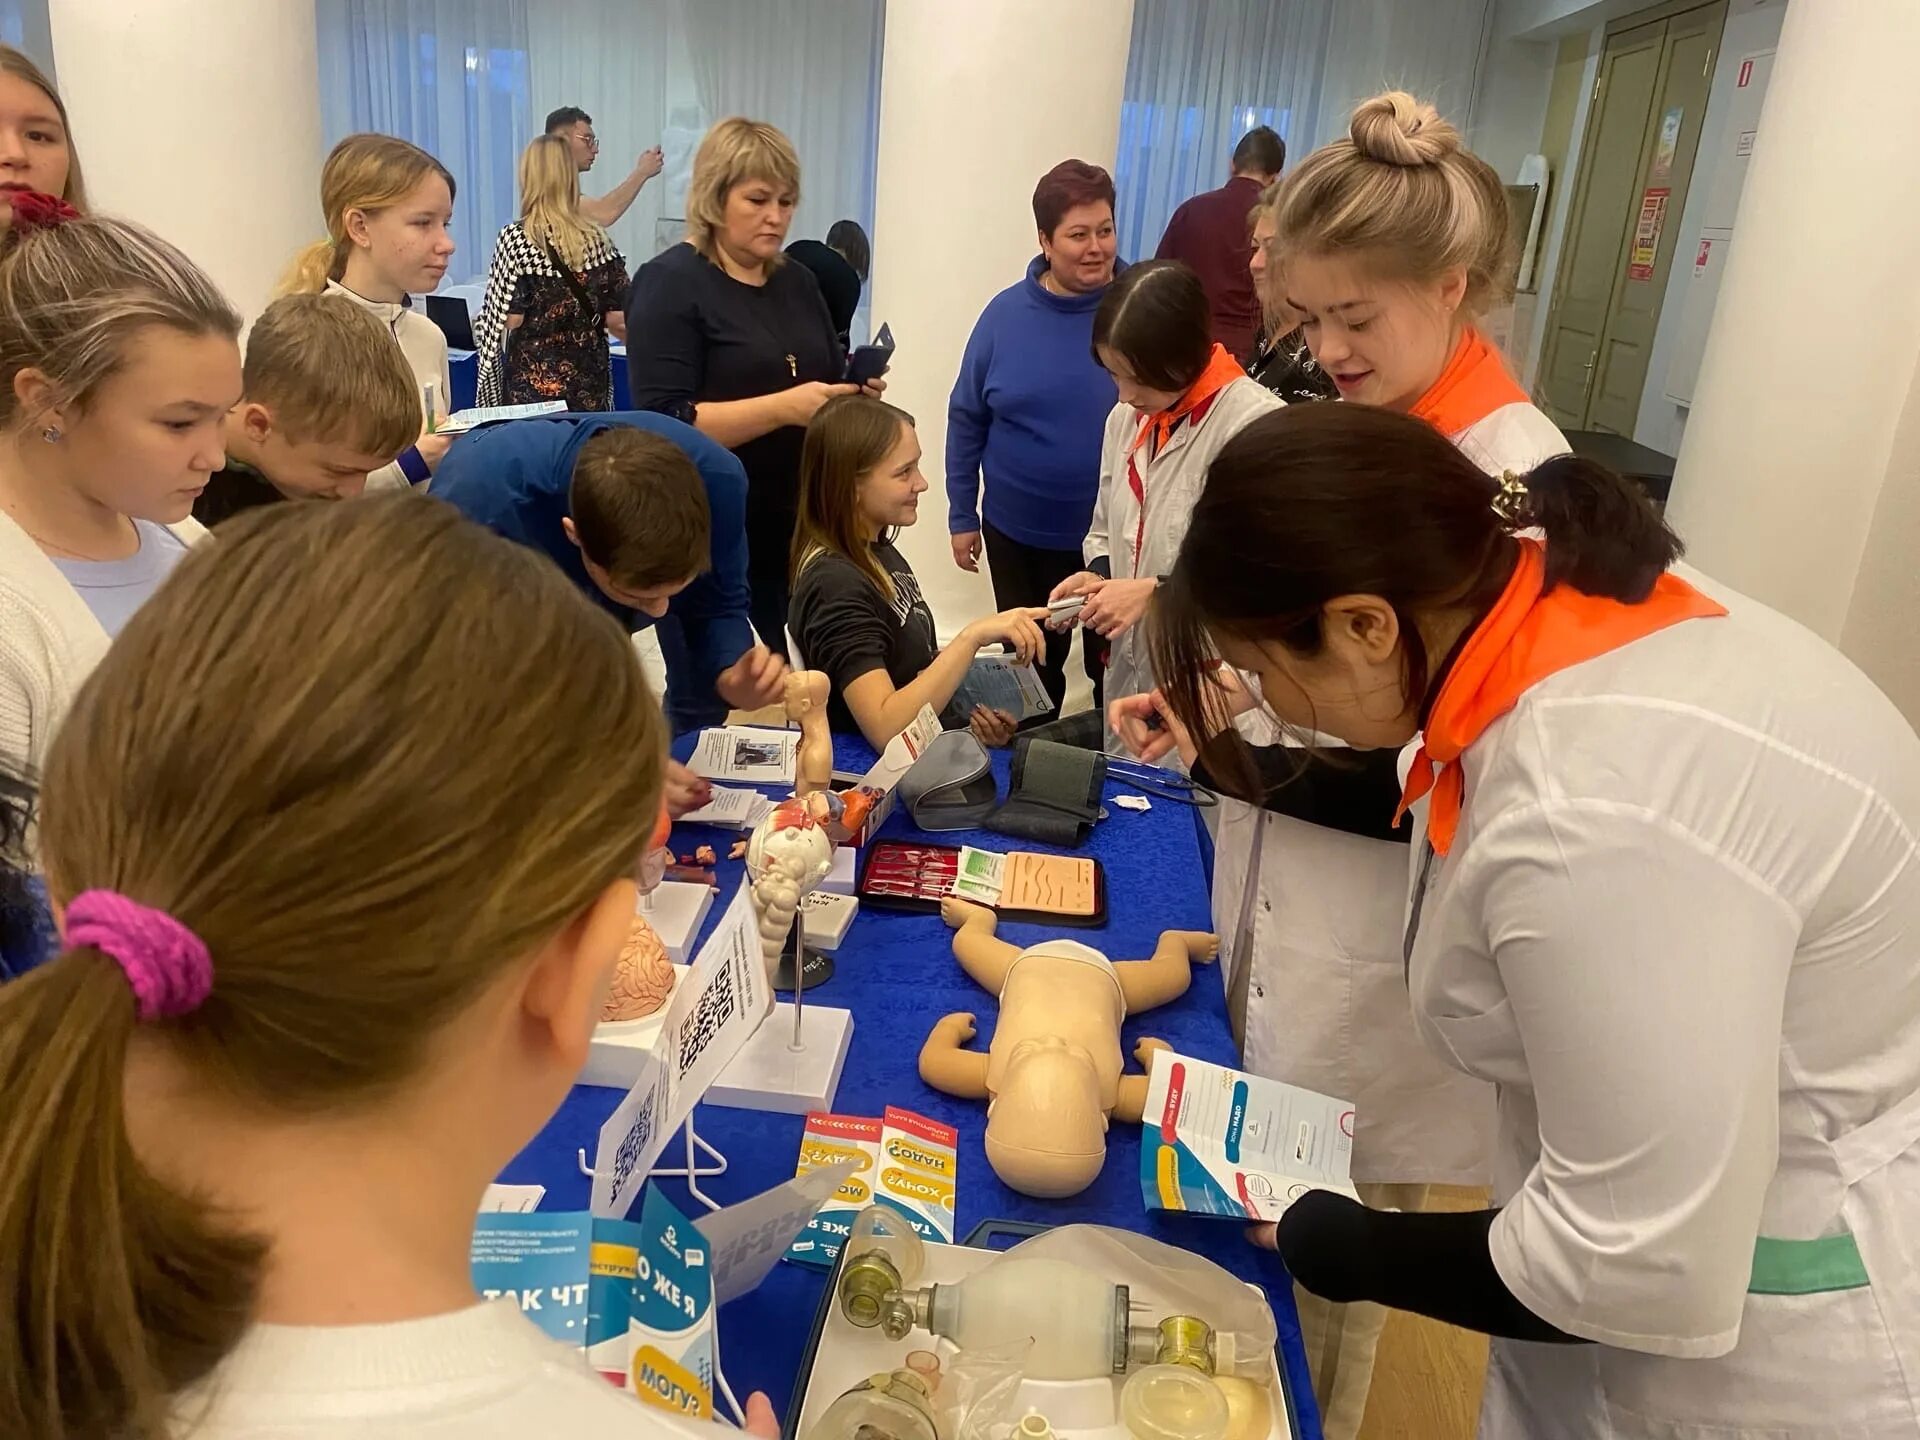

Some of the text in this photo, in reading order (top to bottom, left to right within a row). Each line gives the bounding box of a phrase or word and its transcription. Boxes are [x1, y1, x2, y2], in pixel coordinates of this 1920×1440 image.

[1231, 1104, 1243, 1126] НАДО
[888, 1141, 945, 1169] НАДО?
[887, 1174, 941, 1197] ХОЧУ?
[807, 1219, 850, 1236] ЖЕ Я
[652, 1268, 682, 1308] ЖЕ
[683, 1294, 696, 1319] Я
[640, 1361, 700, 1416] МОГУ?
